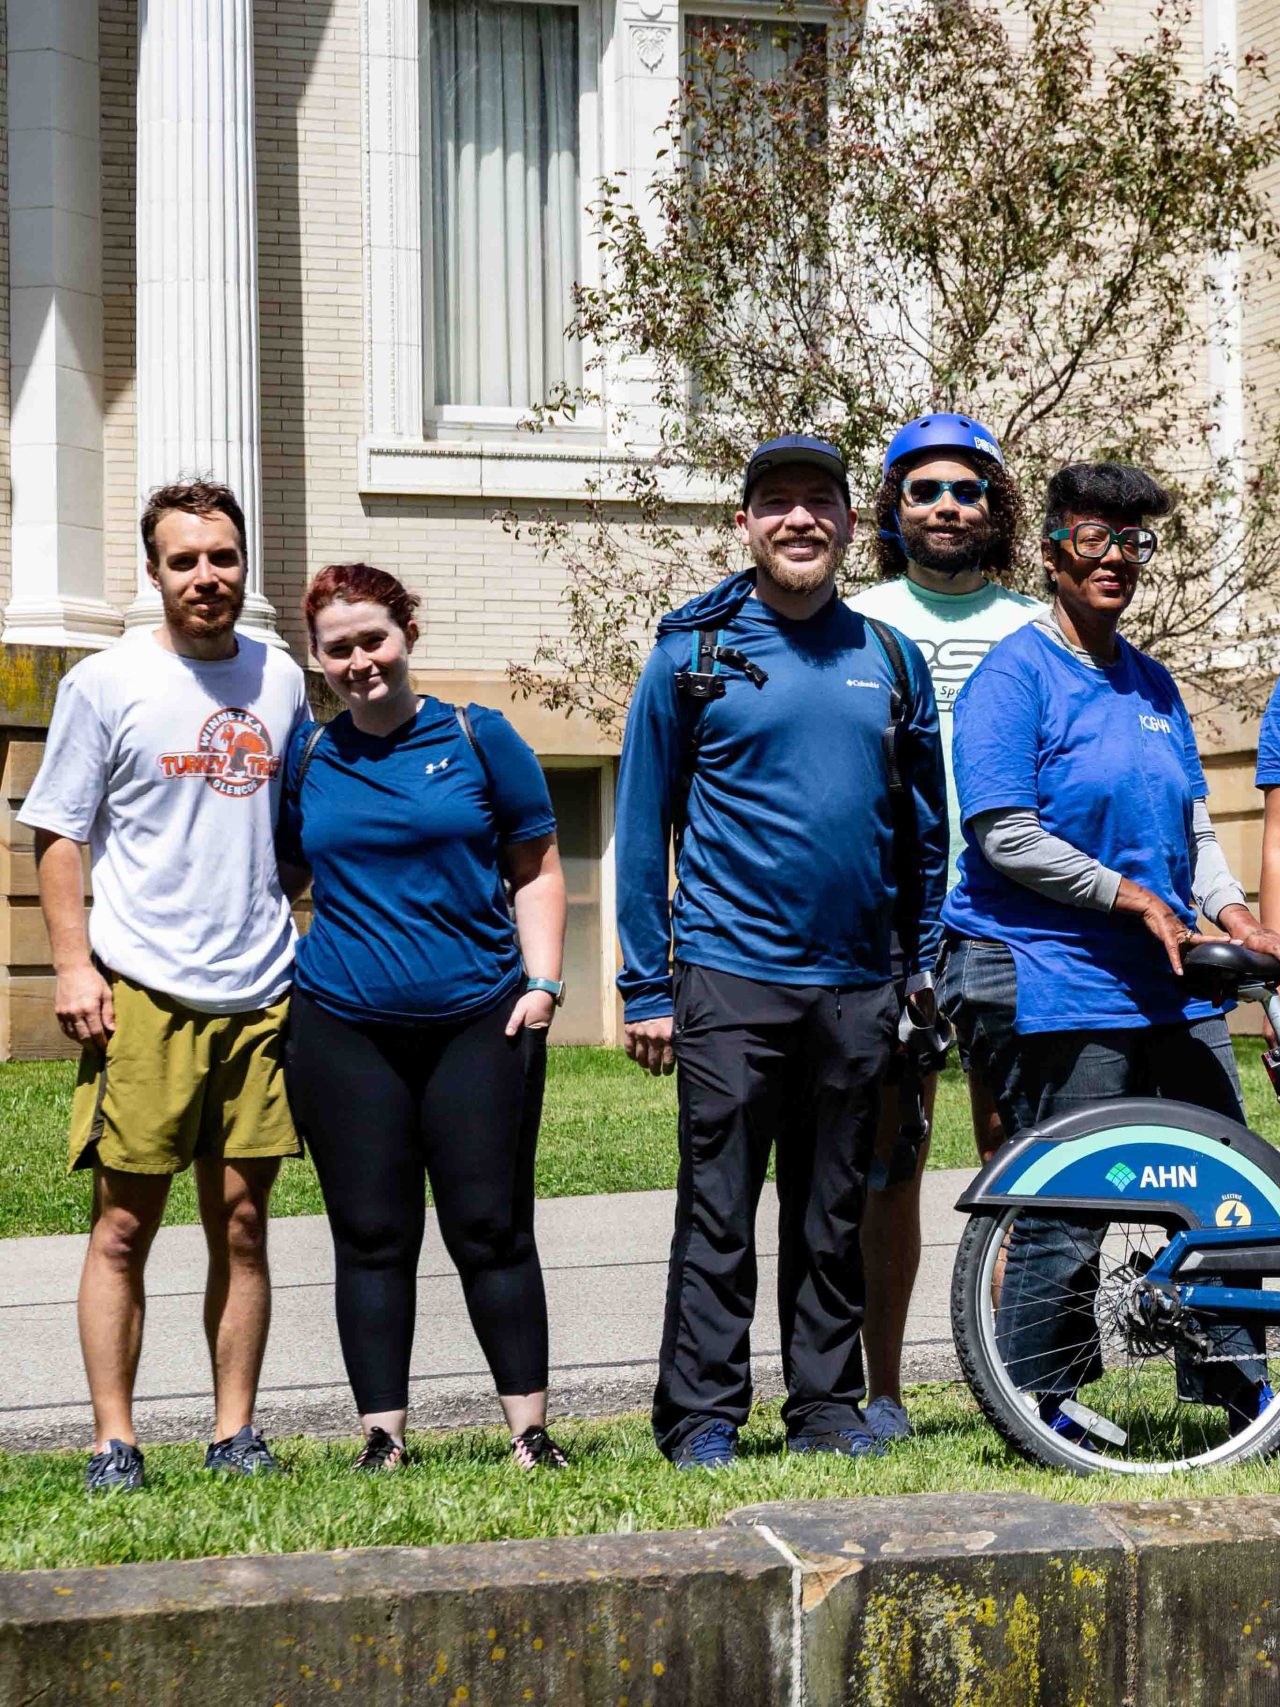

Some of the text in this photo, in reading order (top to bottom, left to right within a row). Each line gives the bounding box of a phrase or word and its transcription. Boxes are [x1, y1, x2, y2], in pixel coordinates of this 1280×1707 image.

[200, 711, 262, 747] WINNETKA
[160, 755, 228, 776] TURKEY
[1139, 1165, 1198, 1189] AHN
